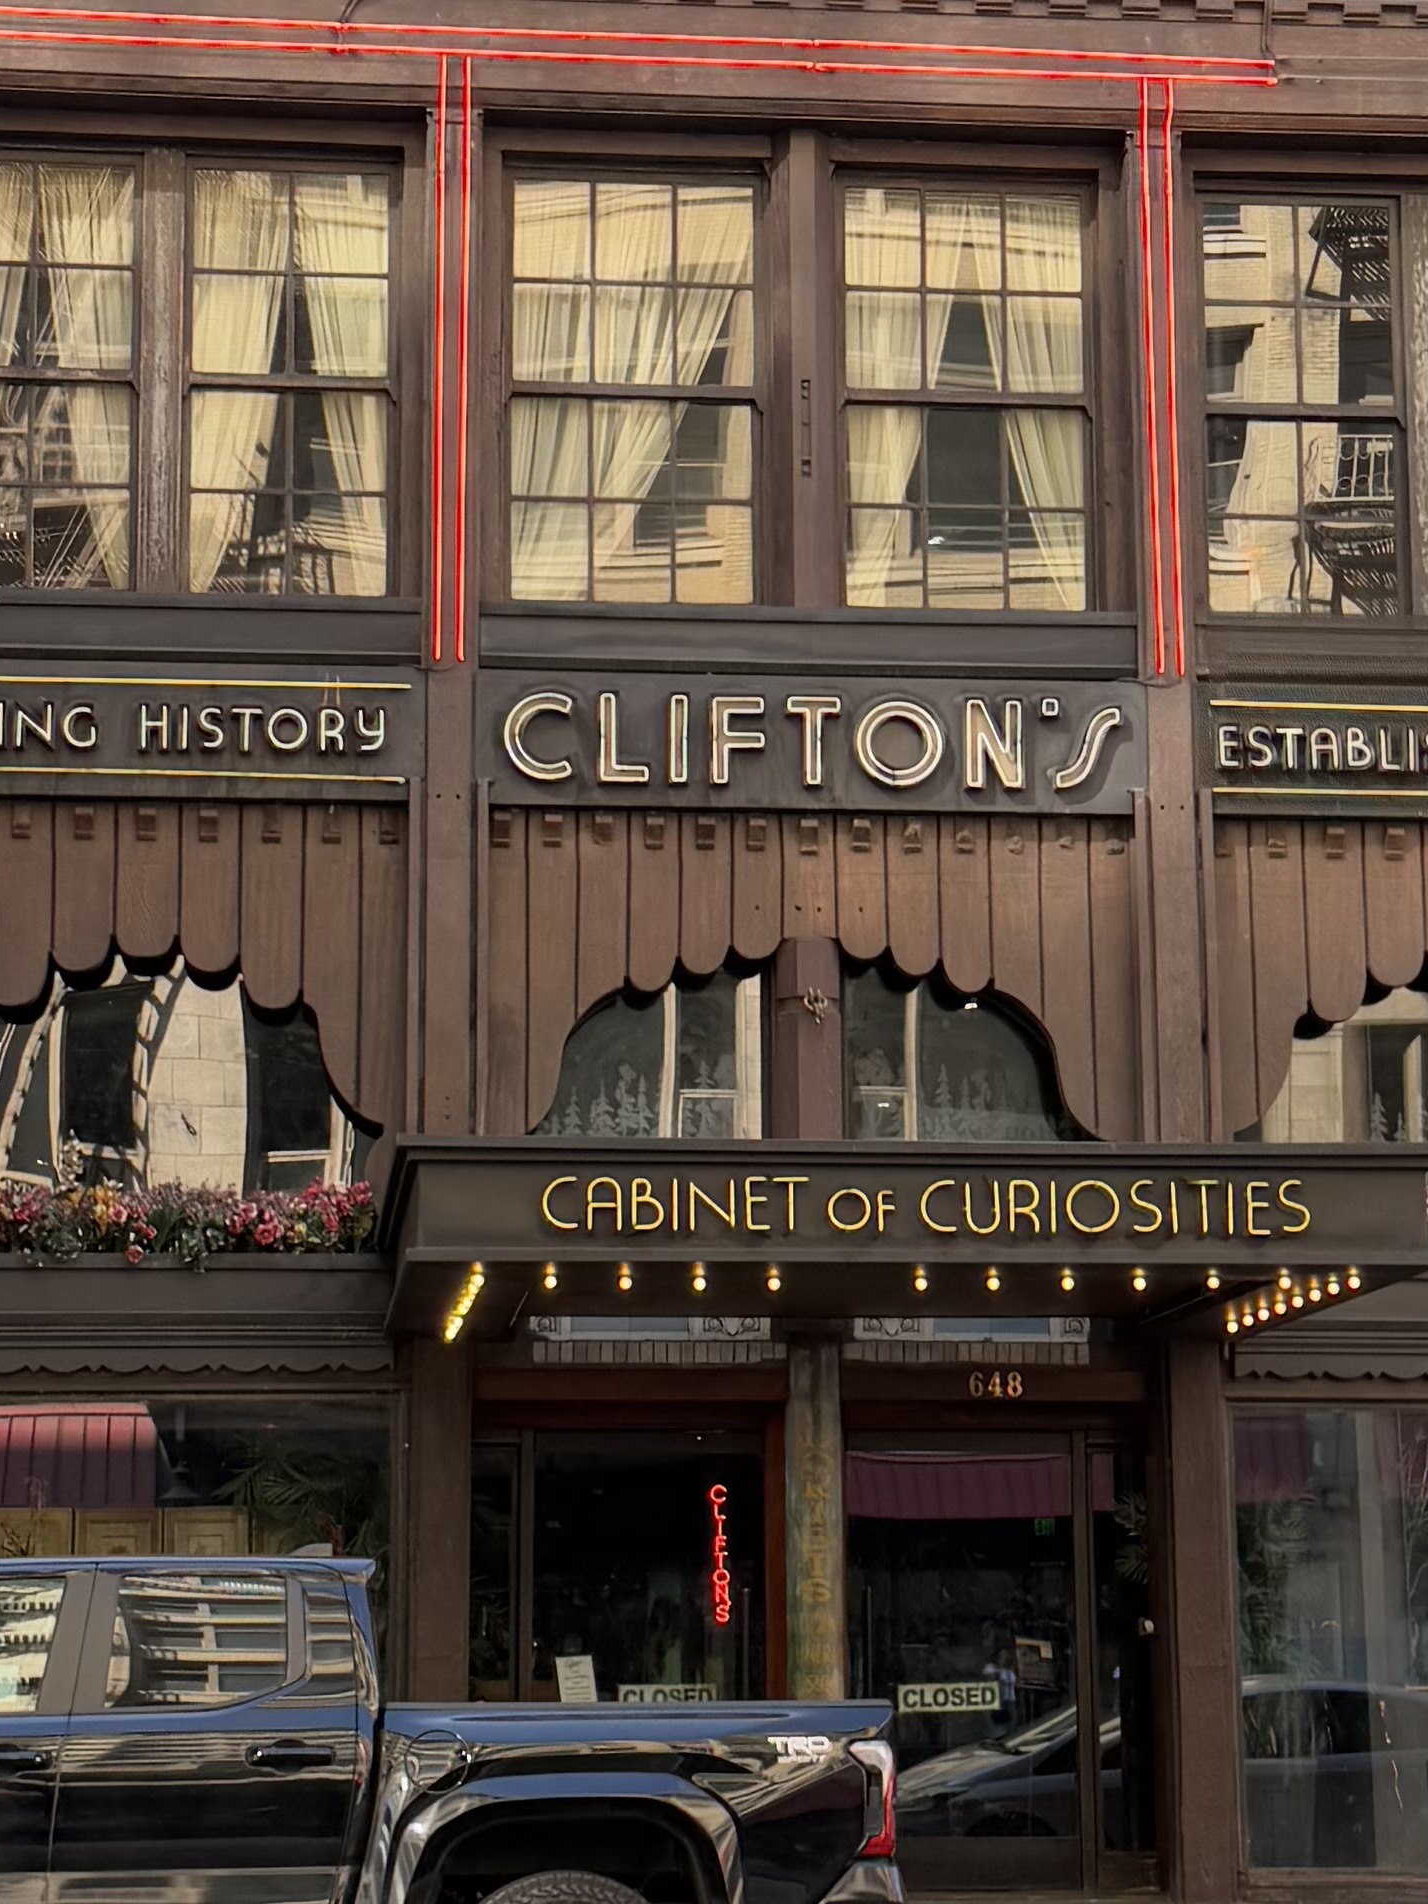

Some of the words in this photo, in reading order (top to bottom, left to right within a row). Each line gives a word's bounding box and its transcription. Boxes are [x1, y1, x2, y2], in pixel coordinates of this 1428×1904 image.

[139, 703, 387, 753] HISTORY
[502, 691, 1122, 790] CLIFTON'S
[540, 1174, 810, 1233] CABINET
[825, 1187, 896, 1233] OF
[919, 1178, 1311, 1237] CURIOSITIES
[969, 1371, 1024, 1399] 648
[903, 1686, 997, 1708] CLOSED
[768, 1736, 830, 1756] TRD
